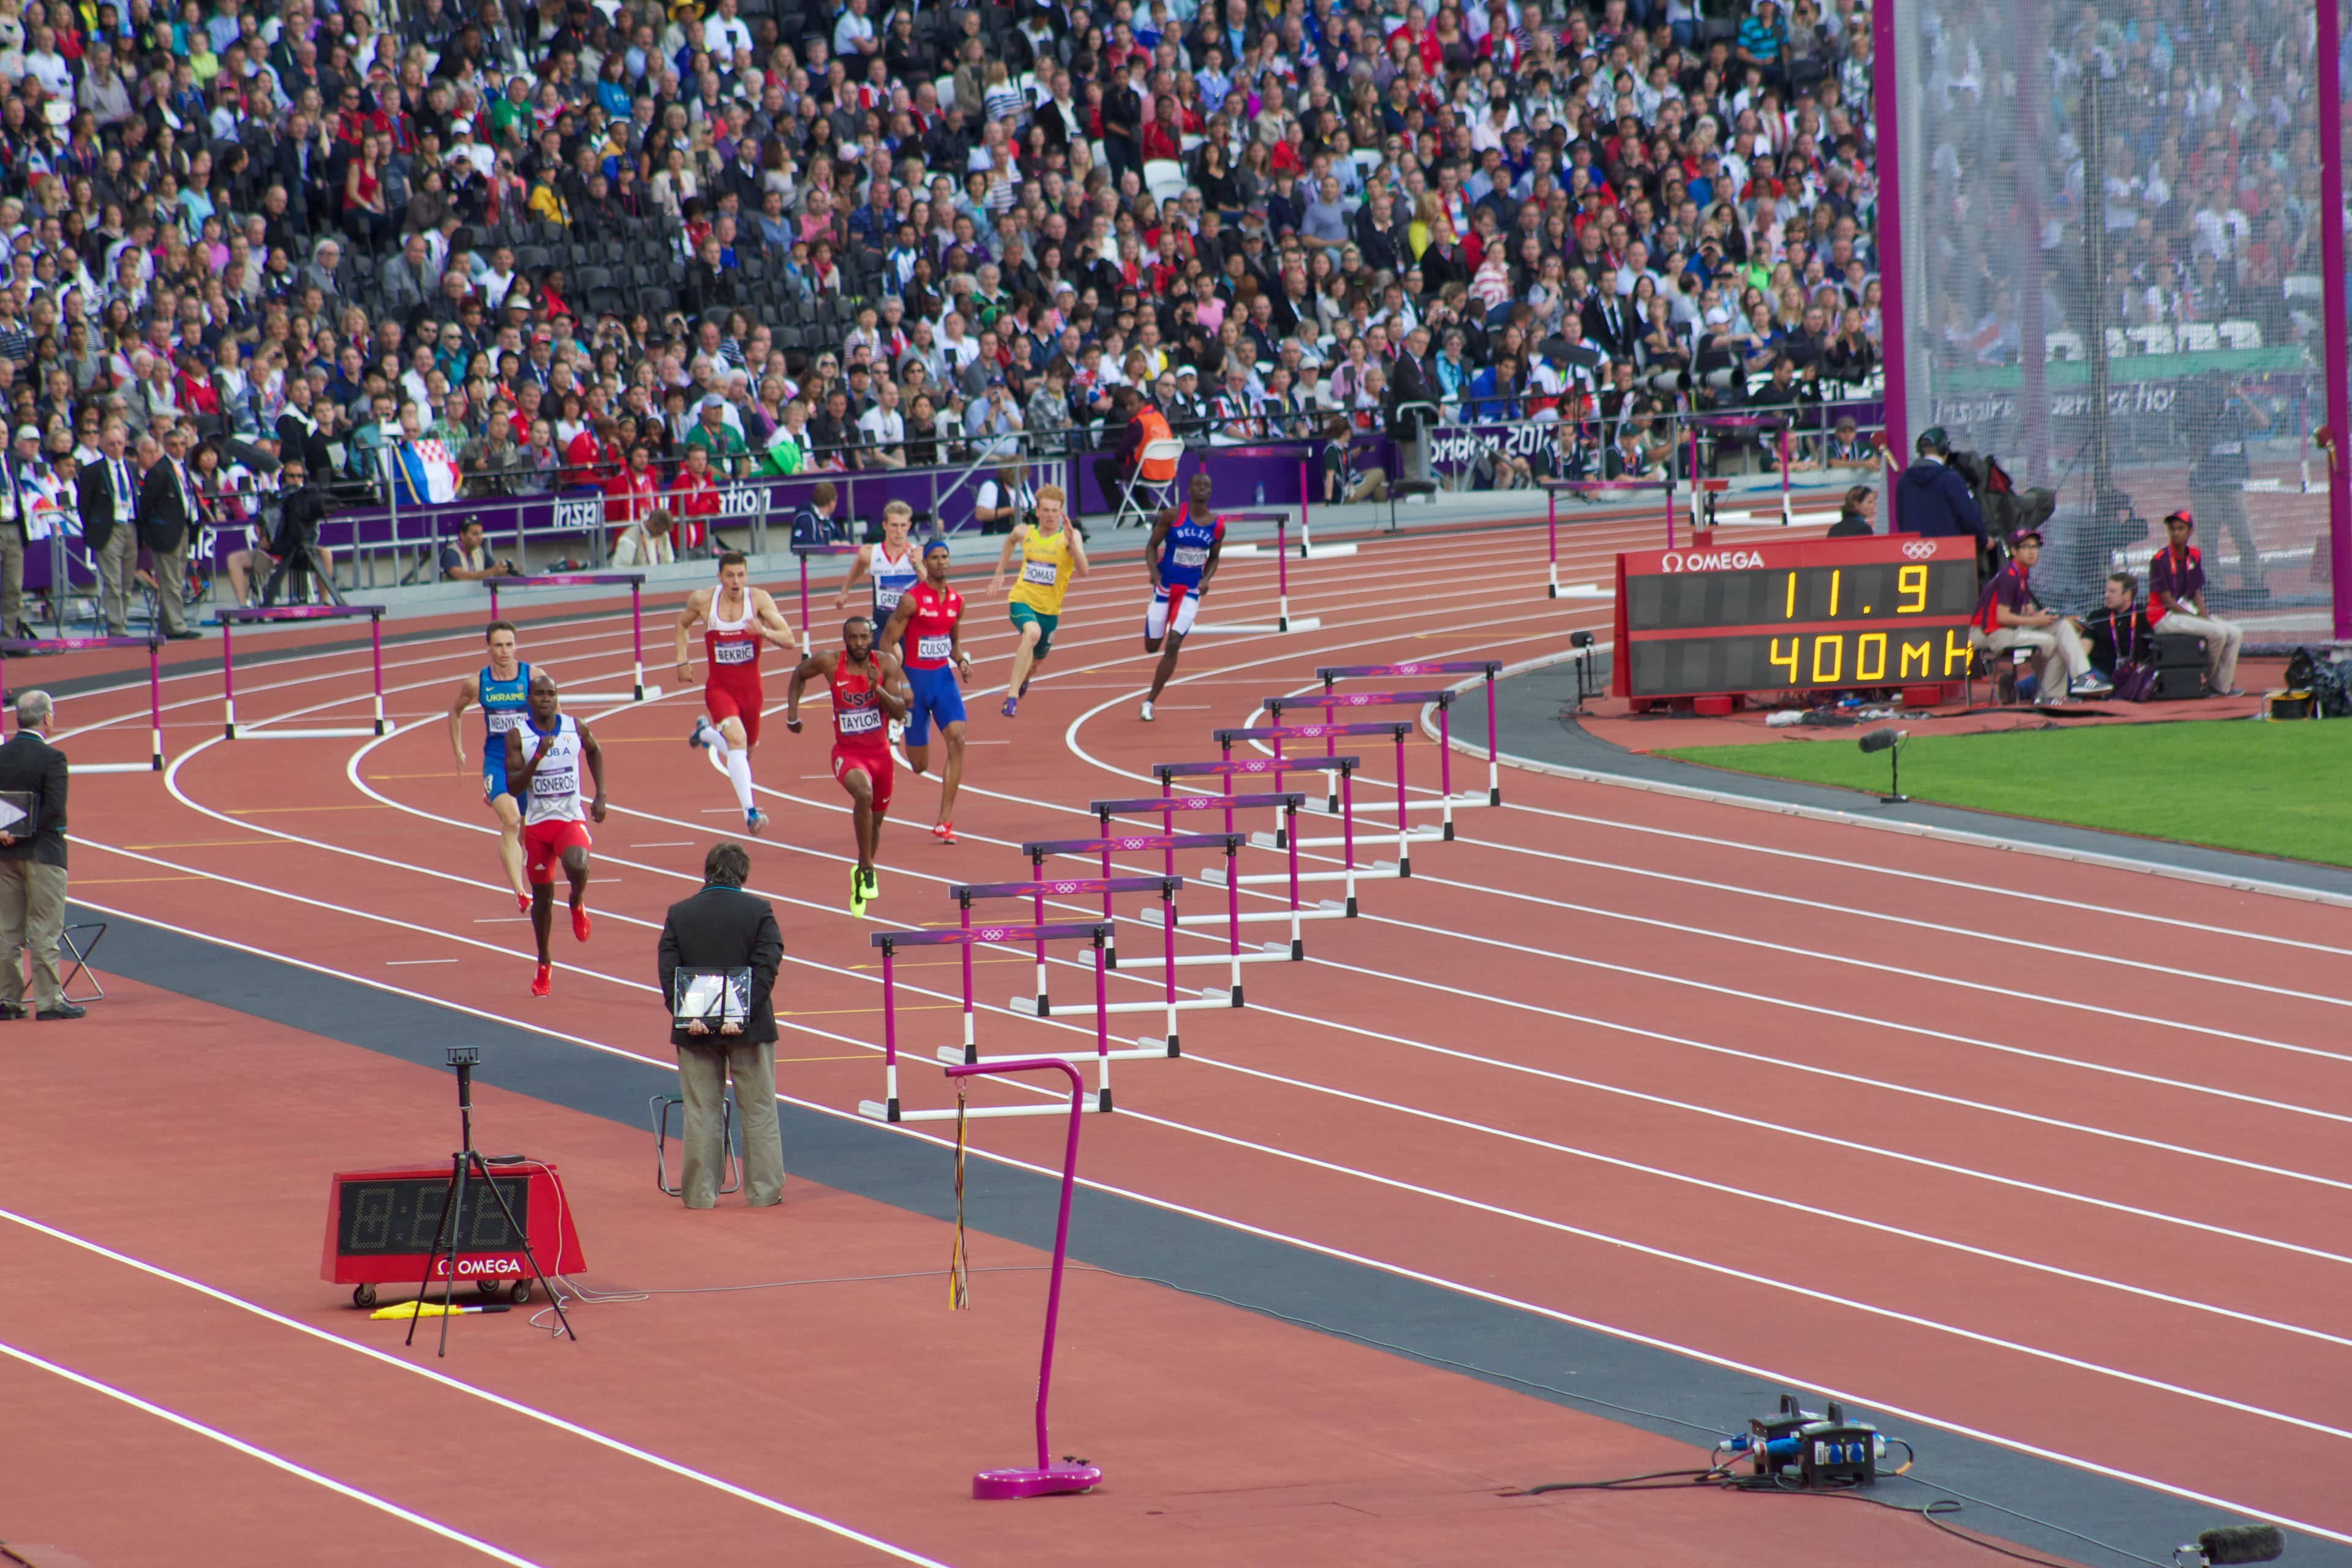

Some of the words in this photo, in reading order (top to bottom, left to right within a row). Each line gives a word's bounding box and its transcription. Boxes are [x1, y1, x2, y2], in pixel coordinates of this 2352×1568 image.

[1430, 427, 1500, 464] ondn
[553, 492, 603, 533] Insp
[1687, 550, 1765, 571] OMEGA
[1025, 567, 1054, 581] THOMAS
[881, 593, 898, 605] GRE
[1786, 565, 1928, 619] 11.9
[718, 647, 752, 661] BEKRIC
[921, 642, 951, 655] CULSON
[486, 692, 525, 703] UKRAINE
[842, 690, 874, 706] USA
[841, 713, 879, 729] TAYLOR
[546, 747, 571, 758] UBA
[534, 775, 575, 793] CISNEROS
[458, 1258, 521, 1274] OMEGA
